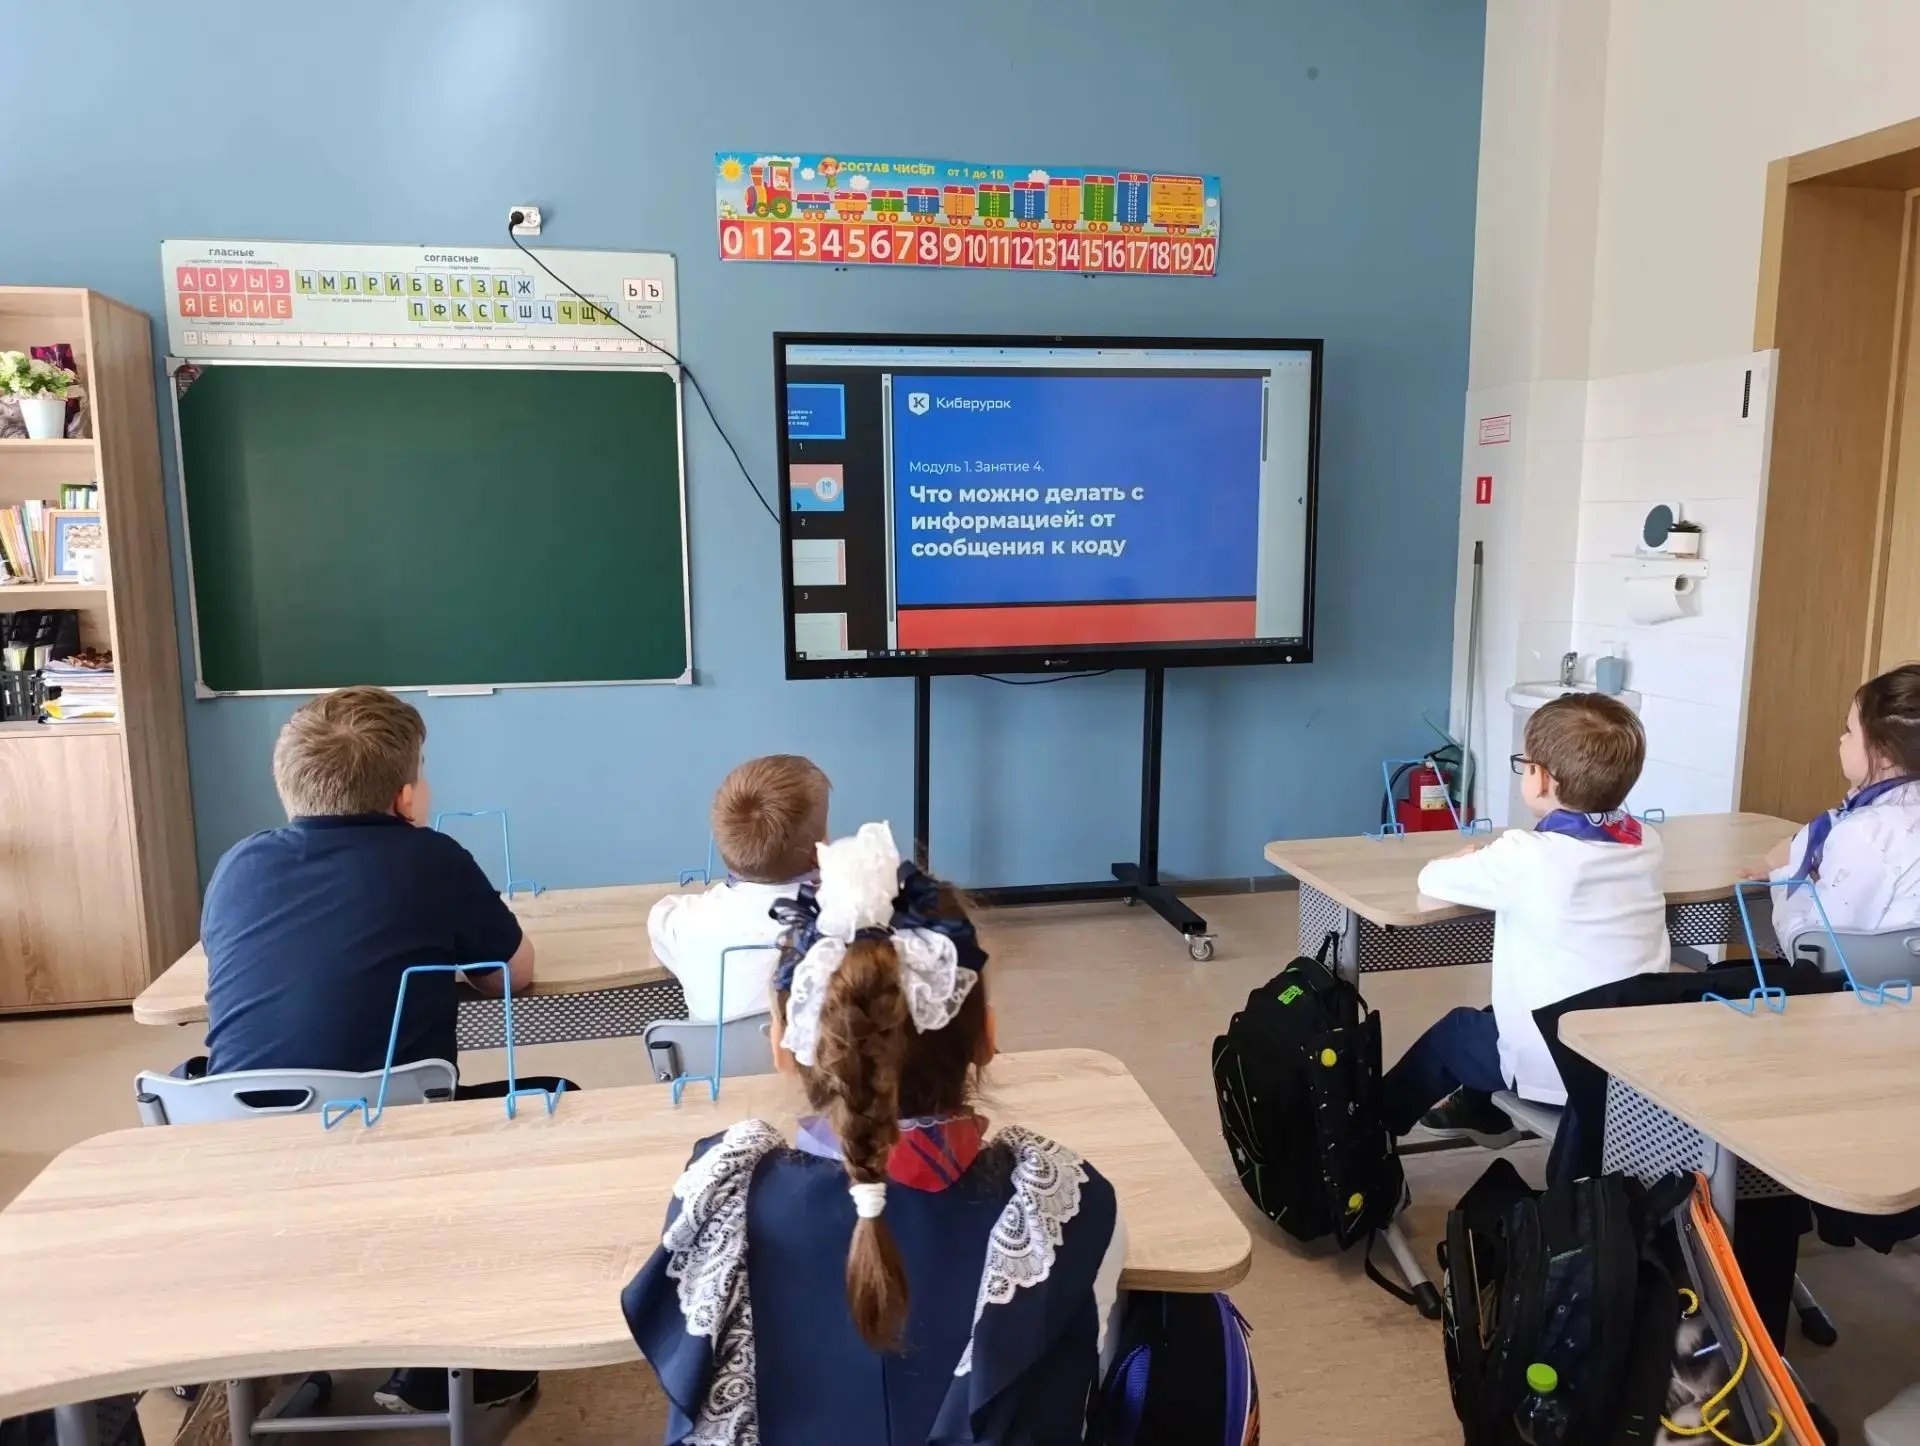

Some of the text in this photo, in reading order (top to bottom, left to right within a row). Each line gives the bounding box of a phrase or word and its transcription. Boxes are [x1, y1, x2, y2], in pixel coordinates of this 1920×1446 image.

[838, 161, 889, 173] СОСТАВ
[947, 168, 960, 177] от
[963, 168, 969, 178] 1
[972, 170, 987, 180] до
[990, 169, 1004, 180] 10
[208, 247, 255, 257] гласные
[723, 226, 1215, 271] 0 1 2 3 4 5 6 7 8 9 10 11 12 13 14 15 16 17 18 19 20
[424, 254, 479, 263] согласные
[183, 272, 284, 288] А О У Ы Э
[301, 274, 400, 291] Н М Л Р Й
[412, 278, 531, 296] Б В Г З Д Ж
[184, 296, 286, 314] Я Ё Ю И Е
[413, 303, 613, 322] П Ф К С Т Ш Ц Ч Щ Х
[936, 396, 1012, 412] Киберурок
[909, 460, 1045, 475] Модуль 1. Занятие 4.
[909, 485, 1144, 504] Что можно делать с
[911, 510, 1116, 534] информацией: от
[911, 538, 1126, 558] сообщения к коду
[804, 592, 808, 600] 3
